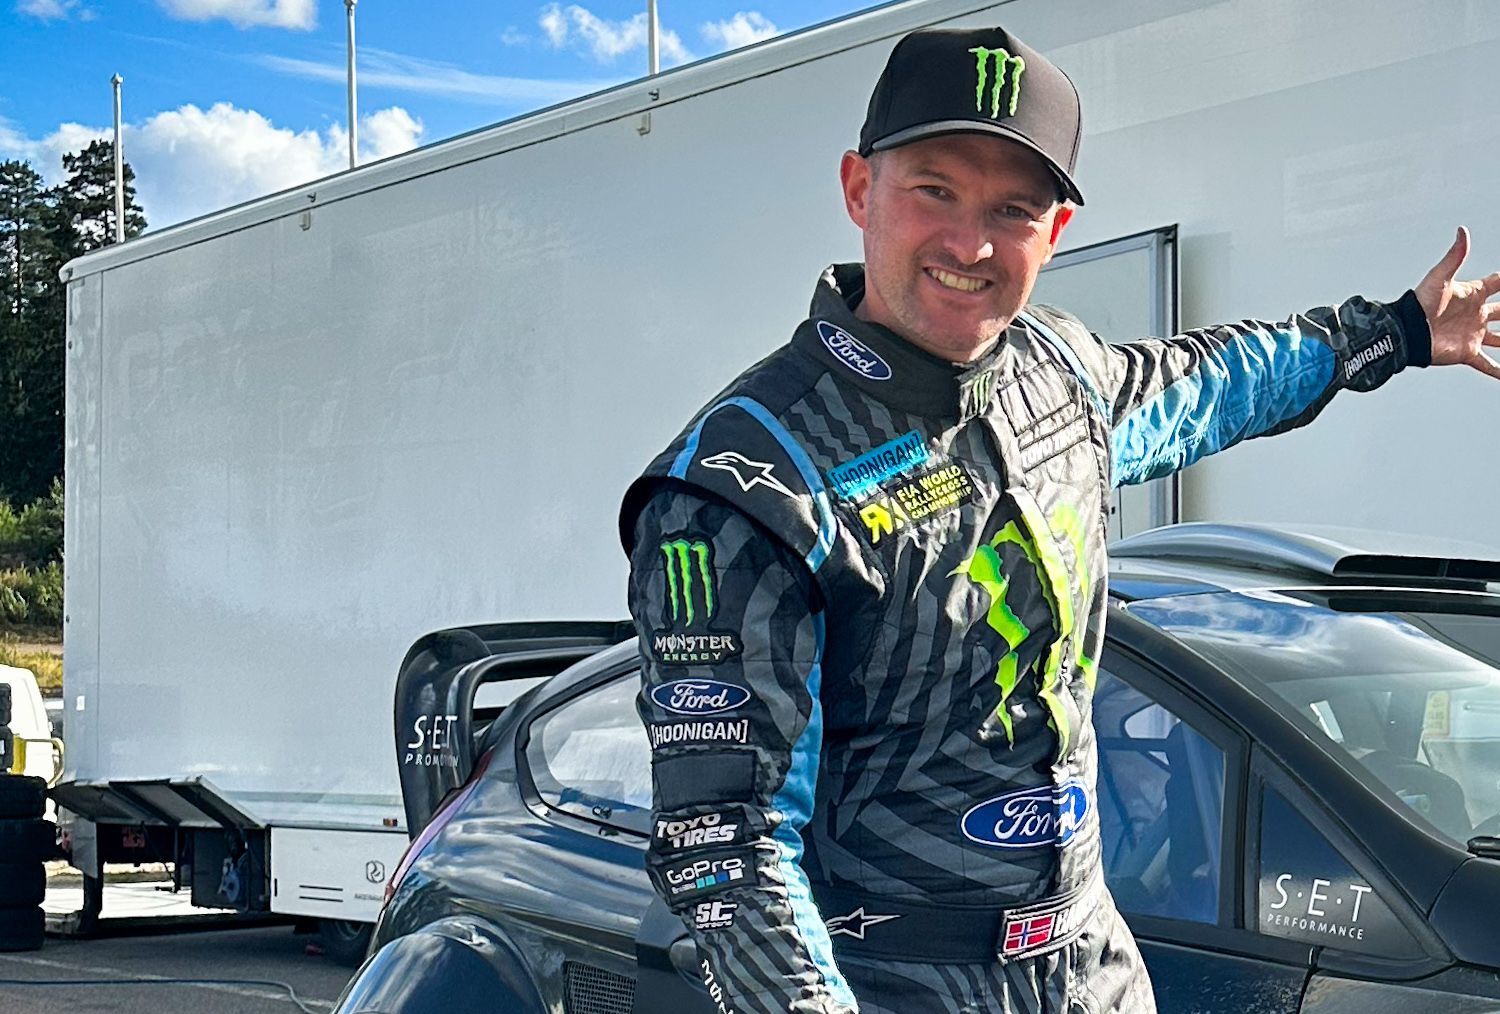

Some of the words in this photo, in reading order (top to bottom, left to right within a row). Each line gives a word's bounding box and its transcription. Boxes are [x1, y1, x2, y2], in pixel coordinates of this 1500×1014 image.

[828, 331, 878, 374] Ford
[896, 484, 920, 503] FIA
[919, 465, 961, 491] WORLD
[904, 476, 968, 512] RALLYCROSS
[911, 486, 973, 519] CHAMPIONHIP
[663, 652, 721, 661] ENERGY
[670, 683, 729, 709] Ford
[657, 813, 721, 838] TOYO
[993, 793, 1076, 840] Ford
[668, 824, 738, 848] TIRES
[1267, 913, 1364, 940] PERFORMANCE
